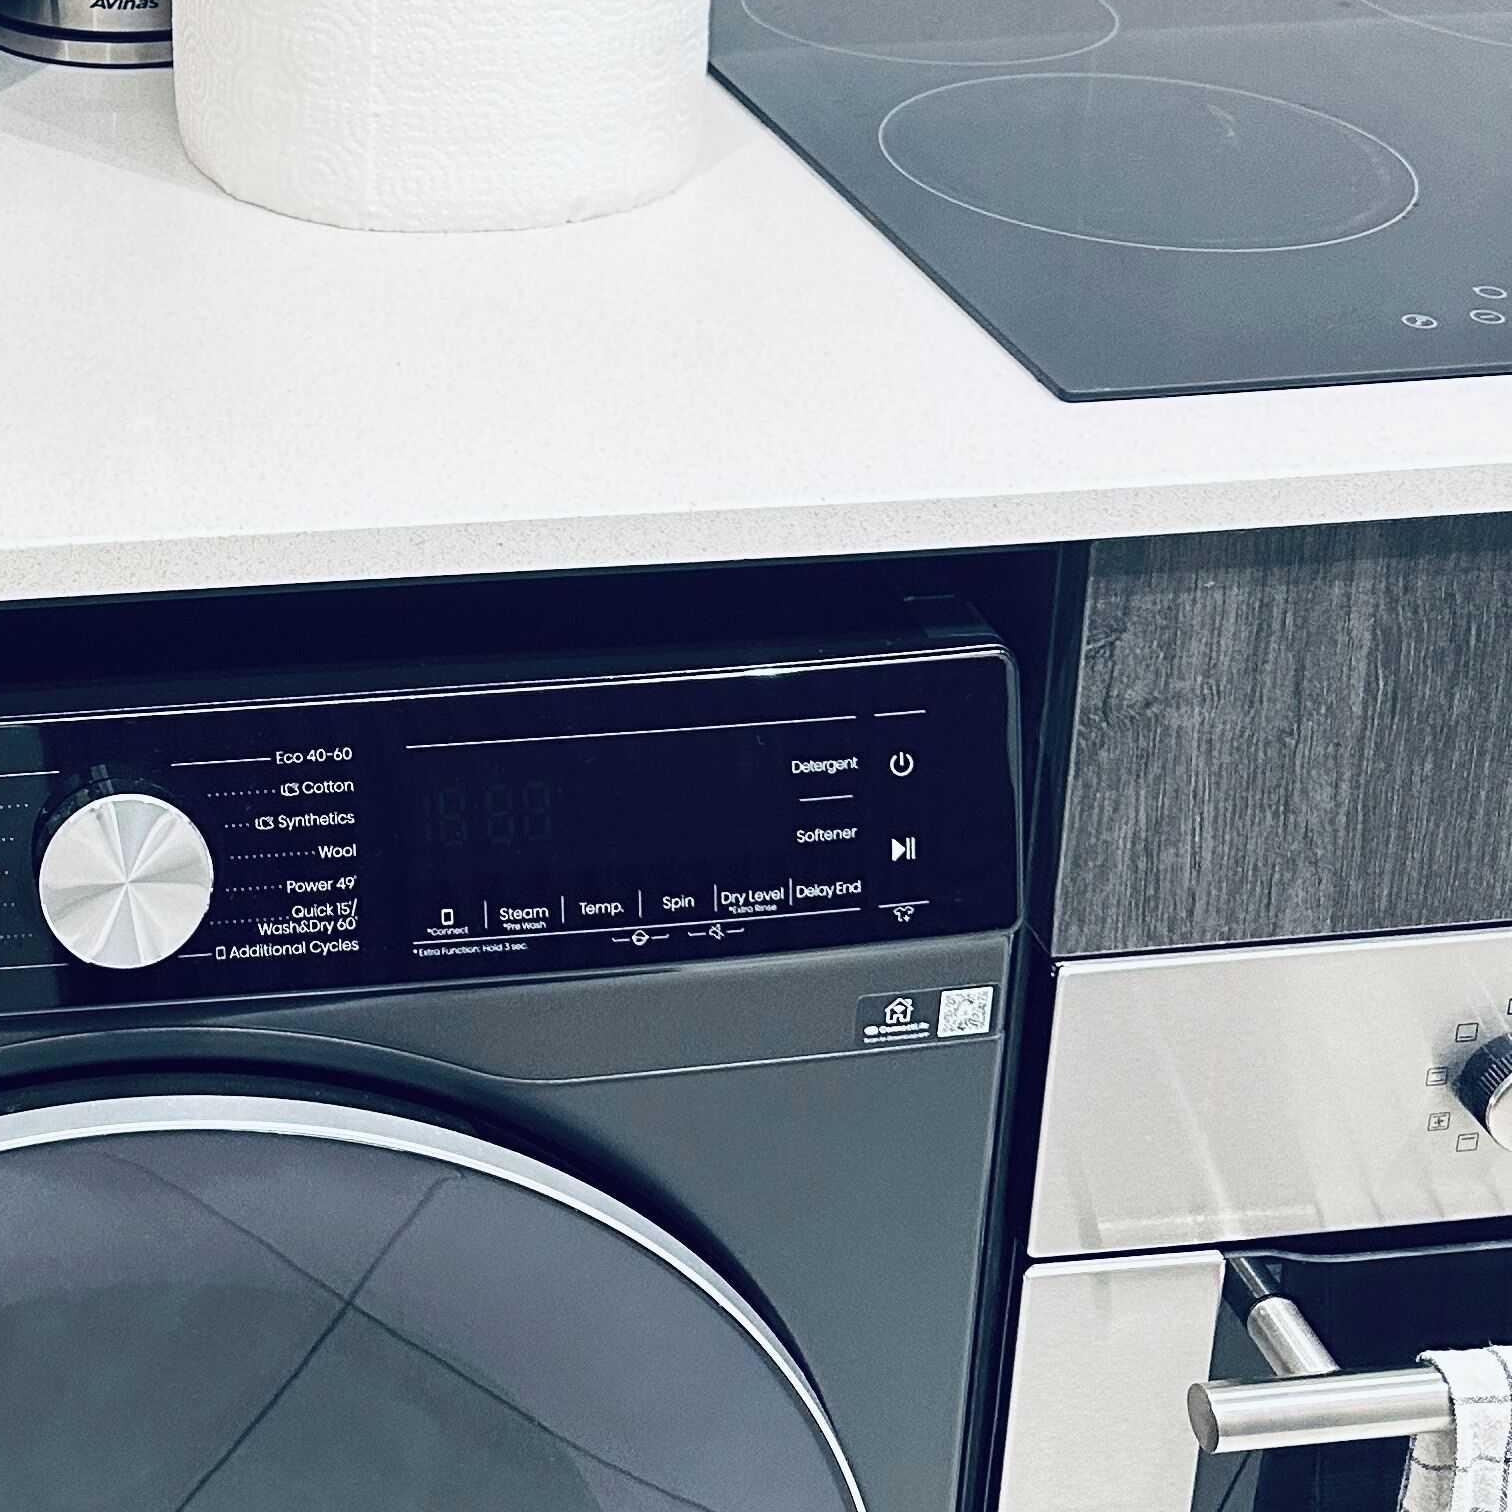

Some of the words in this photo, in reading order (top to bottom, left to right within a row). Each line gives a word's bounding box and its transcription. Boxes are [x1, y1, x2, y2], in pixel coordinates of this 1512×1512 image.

[275, 751, 303, 764] Eco
[306, 747, 352, 762] 40-60
[791, 756, 859, 775] Detergent
[302, 780, 355, 795] Cotton
[278, 811, 355, 831] Synthetics
[796, 828, 858, 843] Softener
[318, 843, 357, 859] Wool
[286, 879, 334, 894] Power
[796, 884, 835, 899] Delay
[836, 880, 862, 895] End
[662, 895, 695, 911] Spin
[720, 890, 746, 906] Dry
[748, 886, 785, 902] Level
[291, 903, 334, 918] Quick
[499, 907, 549, 921] Steam
[579, 900, 624, 917] Temp.
[257, 919, 335, 936] Wash&Dry
[229, 941, 306, 959] Additional
[309, 938, 360, 956] Cycles
